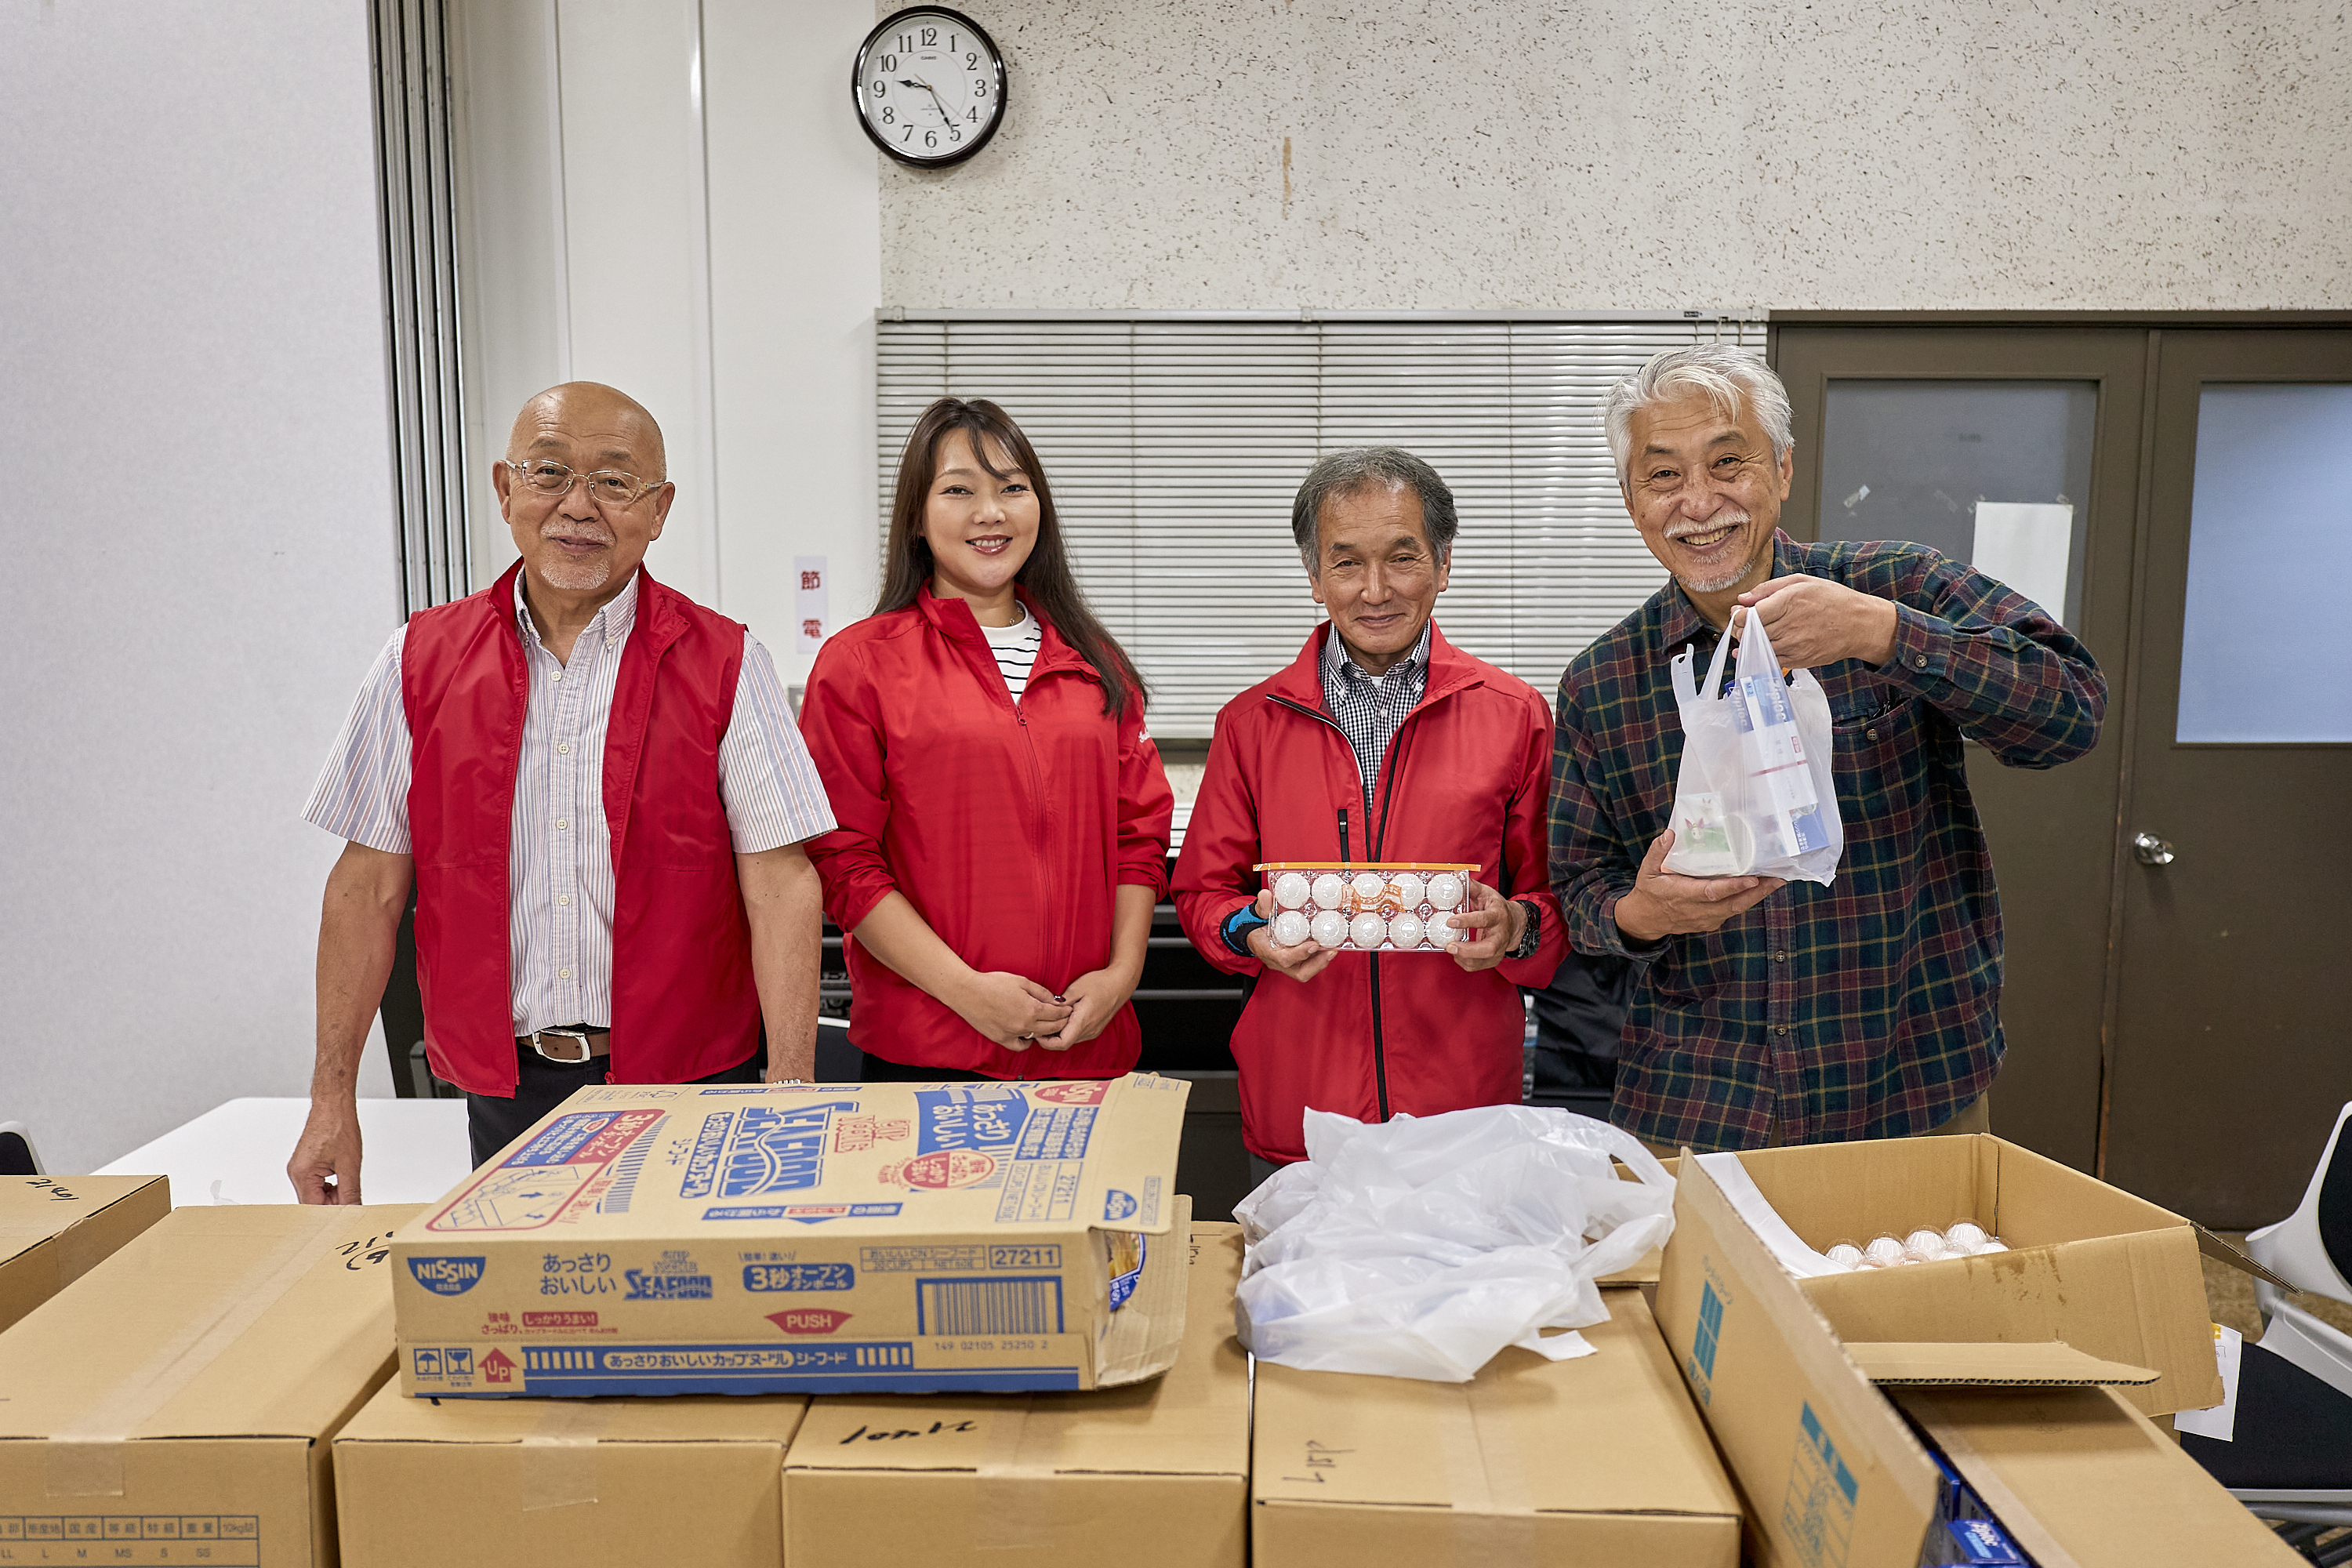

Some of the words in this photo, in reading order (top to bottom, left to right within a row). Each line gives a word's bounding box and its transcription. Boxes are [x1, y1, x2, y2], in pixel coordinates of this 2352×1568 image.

[898, 35, 913, 53] 11
[920, 27, 937, 46] 12
[950, 34, 957, 53] 1
[880, 54, 897, 72] 10
[966, 53, 978, 71] 2
[873, 80, 886, 98] 9
[975, 79, 986, 97] 3
[883, 107, 895, 124] 8
[966, 106, 978, 123] 4
[902, 125, 914, 142] 7
[925, 131, 937, 148] 6
[949, 124, 961, 142] 5
[801, 570, 822, 639] 節電
[932, 1104, 969, 1149] おいしい
[972, 1103, 1012, 1141] あっさり
[665, 1138, 692, 1166] シーフード
[717, 1101, 859, 1199] SEAFOOD
[1054, 1175, 1076, 1204] 27211
[543, 1252, 612, 1273] あっさり
[995, 1249, 1055, 1265] 27211
[417, 1259, 478, 1283] NISSIN
[750, 1266, 790, 1290] 3秒
[791, 1266, 847, 1278] オープン
[540, 1276, 617, 1294] おいしい
[623, 1269, 713, 1301] SEAFOOD
[791, 1279, 848, 1290] ダンボール
[786, 1314, 832, 1328] PUSH
[609, 1351, 789, 1368] あっさりおいしいカップヌードル
[796, 1351, 848, 1365] シーフード
[487, 1360, 509, 1381] UP
[1, 1548, 14, 1559] LL
[42, 1548, 49, 1559] L
[77, 1548, 87, 1559] M
[114, 1548, 132, 1559] MS
[160, 1548, 169, 1559] S
[196, 1547, 211, 1559] SS
